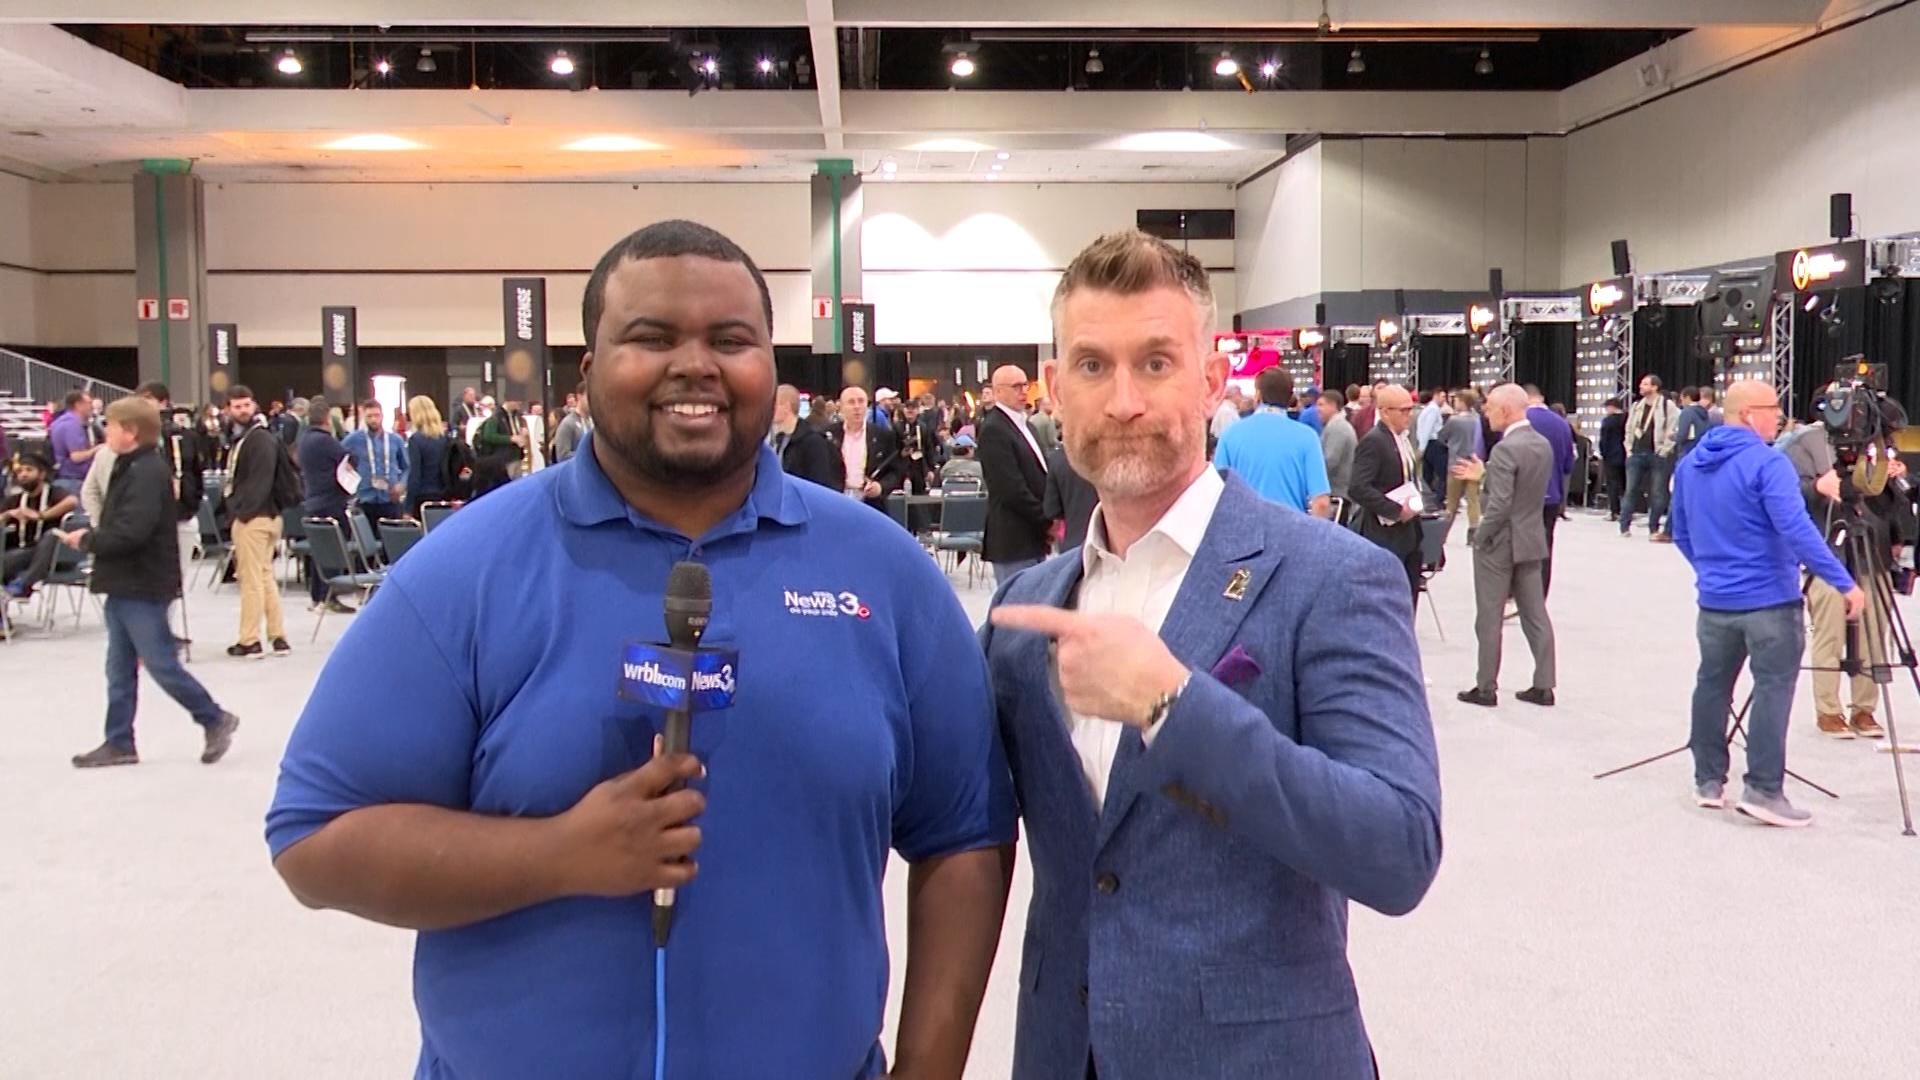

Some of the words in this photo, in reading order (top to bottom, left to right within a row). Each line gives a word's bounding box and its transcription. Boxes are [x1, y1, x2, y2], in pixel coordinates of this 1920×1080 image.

[516, 287, 532, 340] OFFENSE
[332, 313, 346, 356] OFFENSE
[783, 590, 837, 610] News
[838, 591, 860, 616] 3
[691, 671, 722, 691] News
